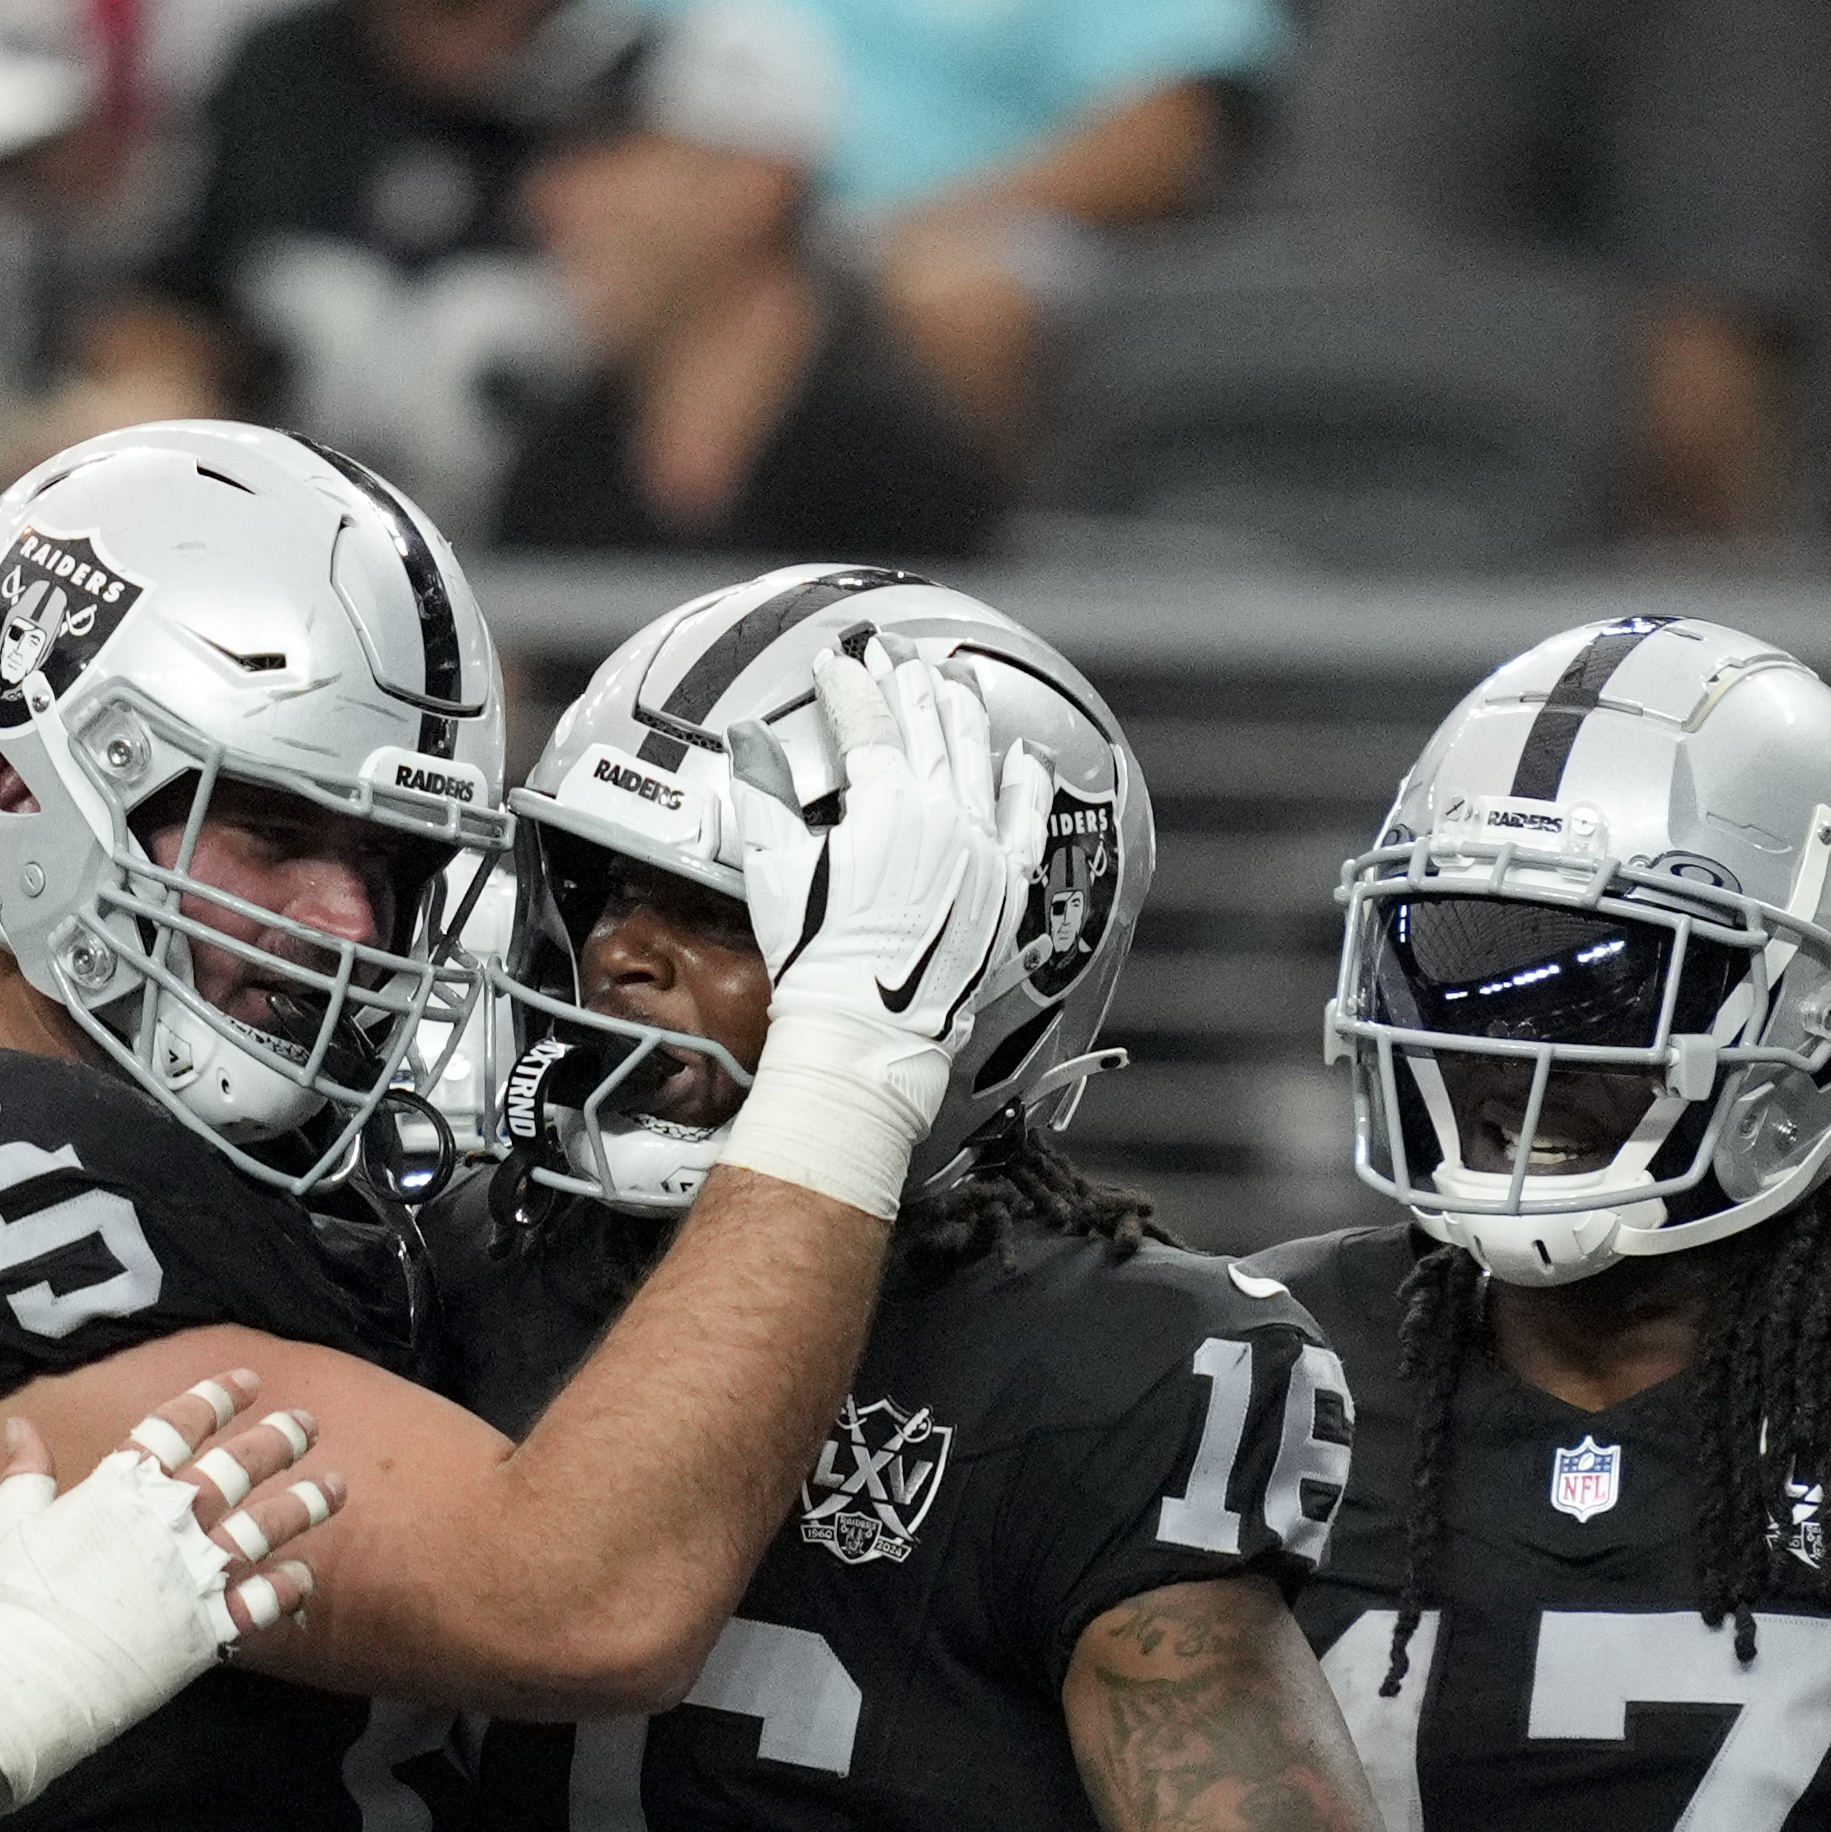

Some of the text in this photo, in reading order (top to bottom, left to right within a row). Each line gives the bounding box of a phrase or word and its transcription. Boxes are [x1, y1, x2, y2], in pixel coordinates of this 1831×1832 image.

[19, 535, 126, 603] RAIDERS
[395, 764, 475, 803] RAIDERS
[593, 758, 686, 811] RAIDERS
[1050, 807, 1109, 838] IDERS
[1487, 810, 1564, 834] RAIDERS
[812, 1439, 935, 1506] LXV
[1562, 1474, 1607, 1506] NFL
[806, 1527, 834, 1539] 1960
[875, 1540, 904, 1557] 2024
